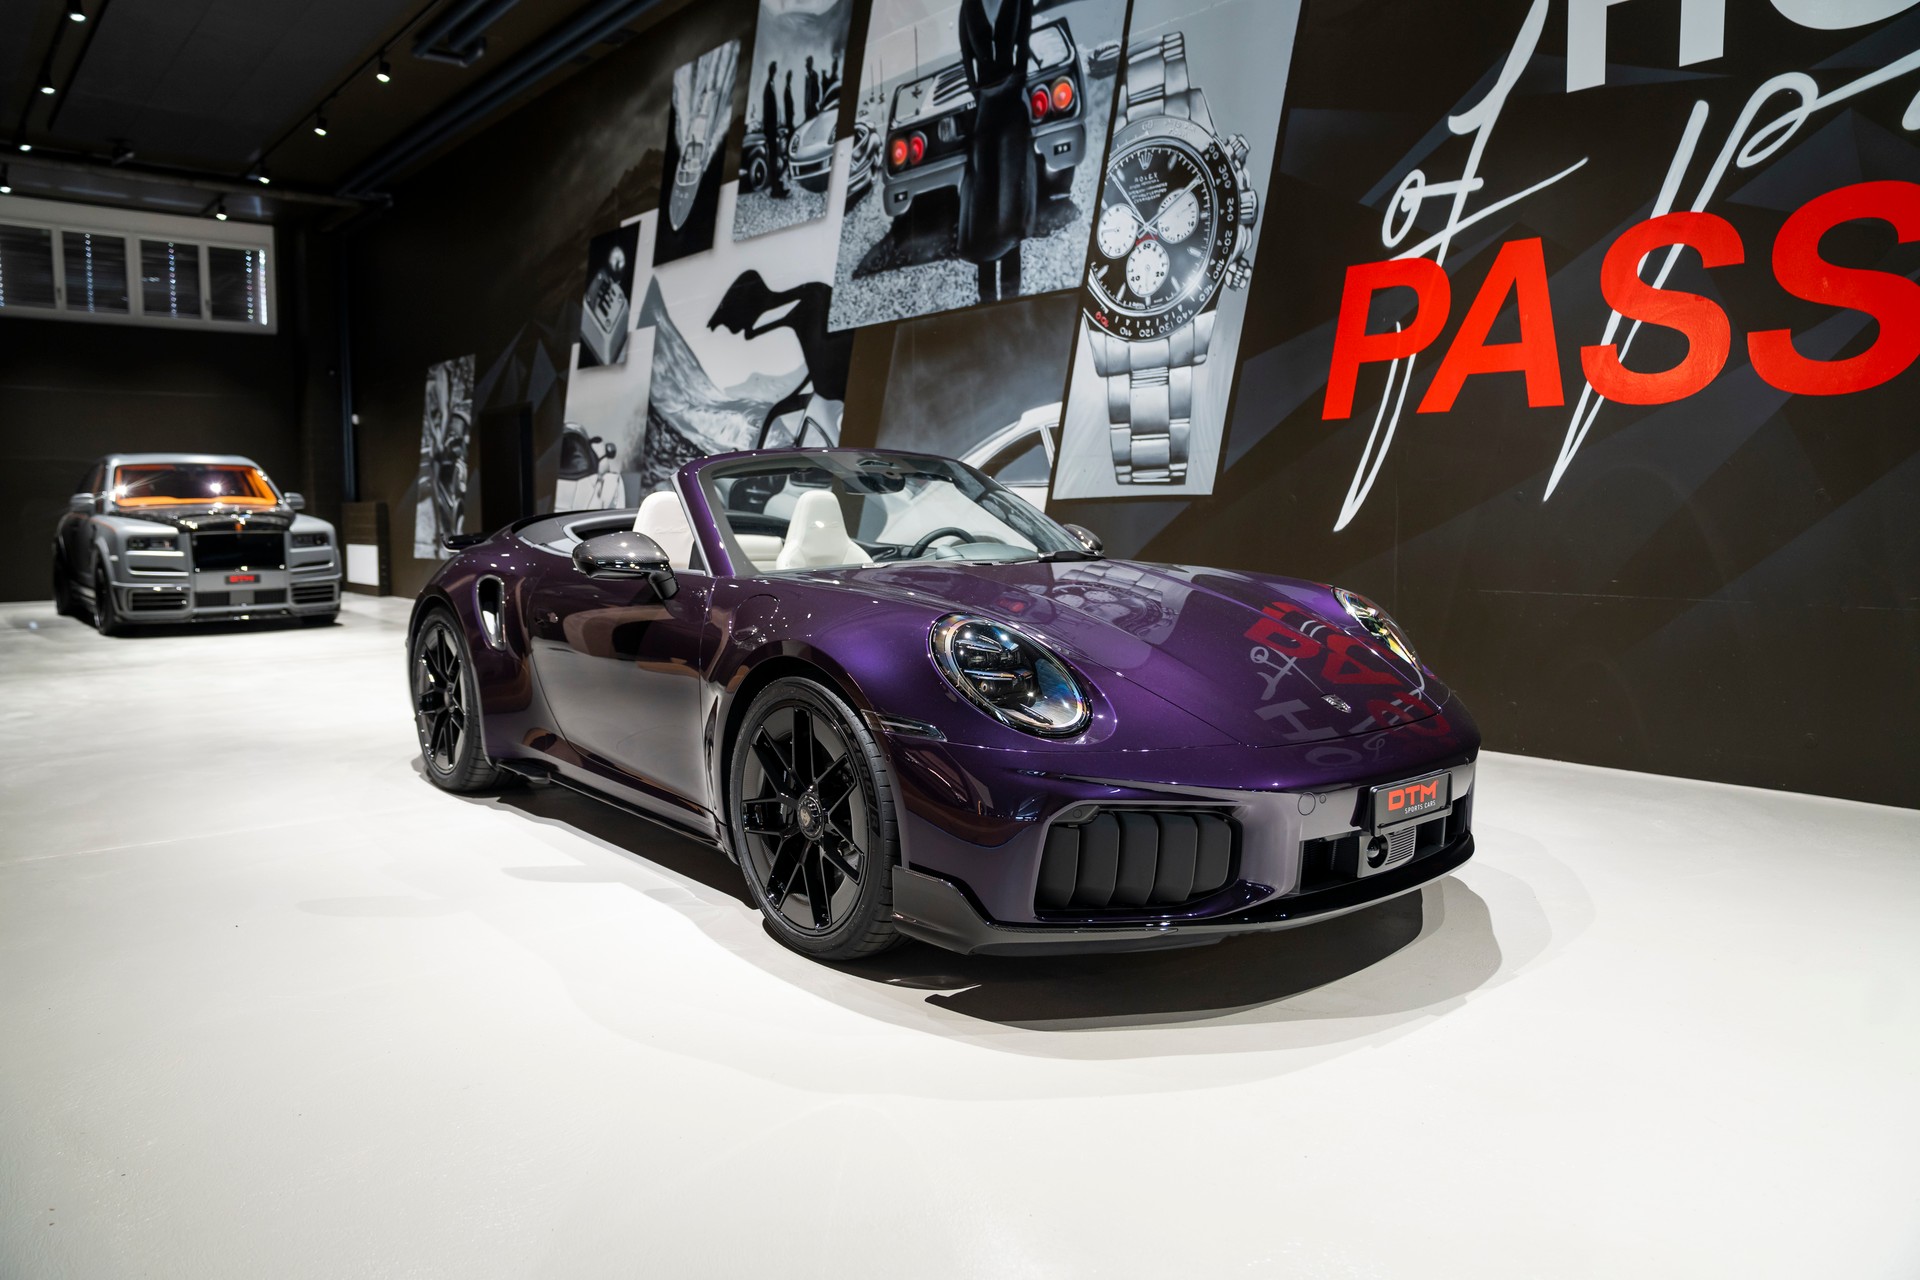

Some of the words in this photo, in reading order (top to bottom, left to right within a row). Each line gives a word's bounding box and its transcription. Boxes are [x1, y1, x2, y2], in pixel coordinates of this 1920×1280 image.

[1218, 164, 1232, 189] 300
[1226, 197, 1234, 222] 240
[1222, 230, 1233, 255] 200
[1322, 180, 1920, 420] PASS
[1388, 780, 1438, 811] DTM
[1404, 804, 1424, 814] SPORTS
[1424, 800, 1436, 810] CARS
